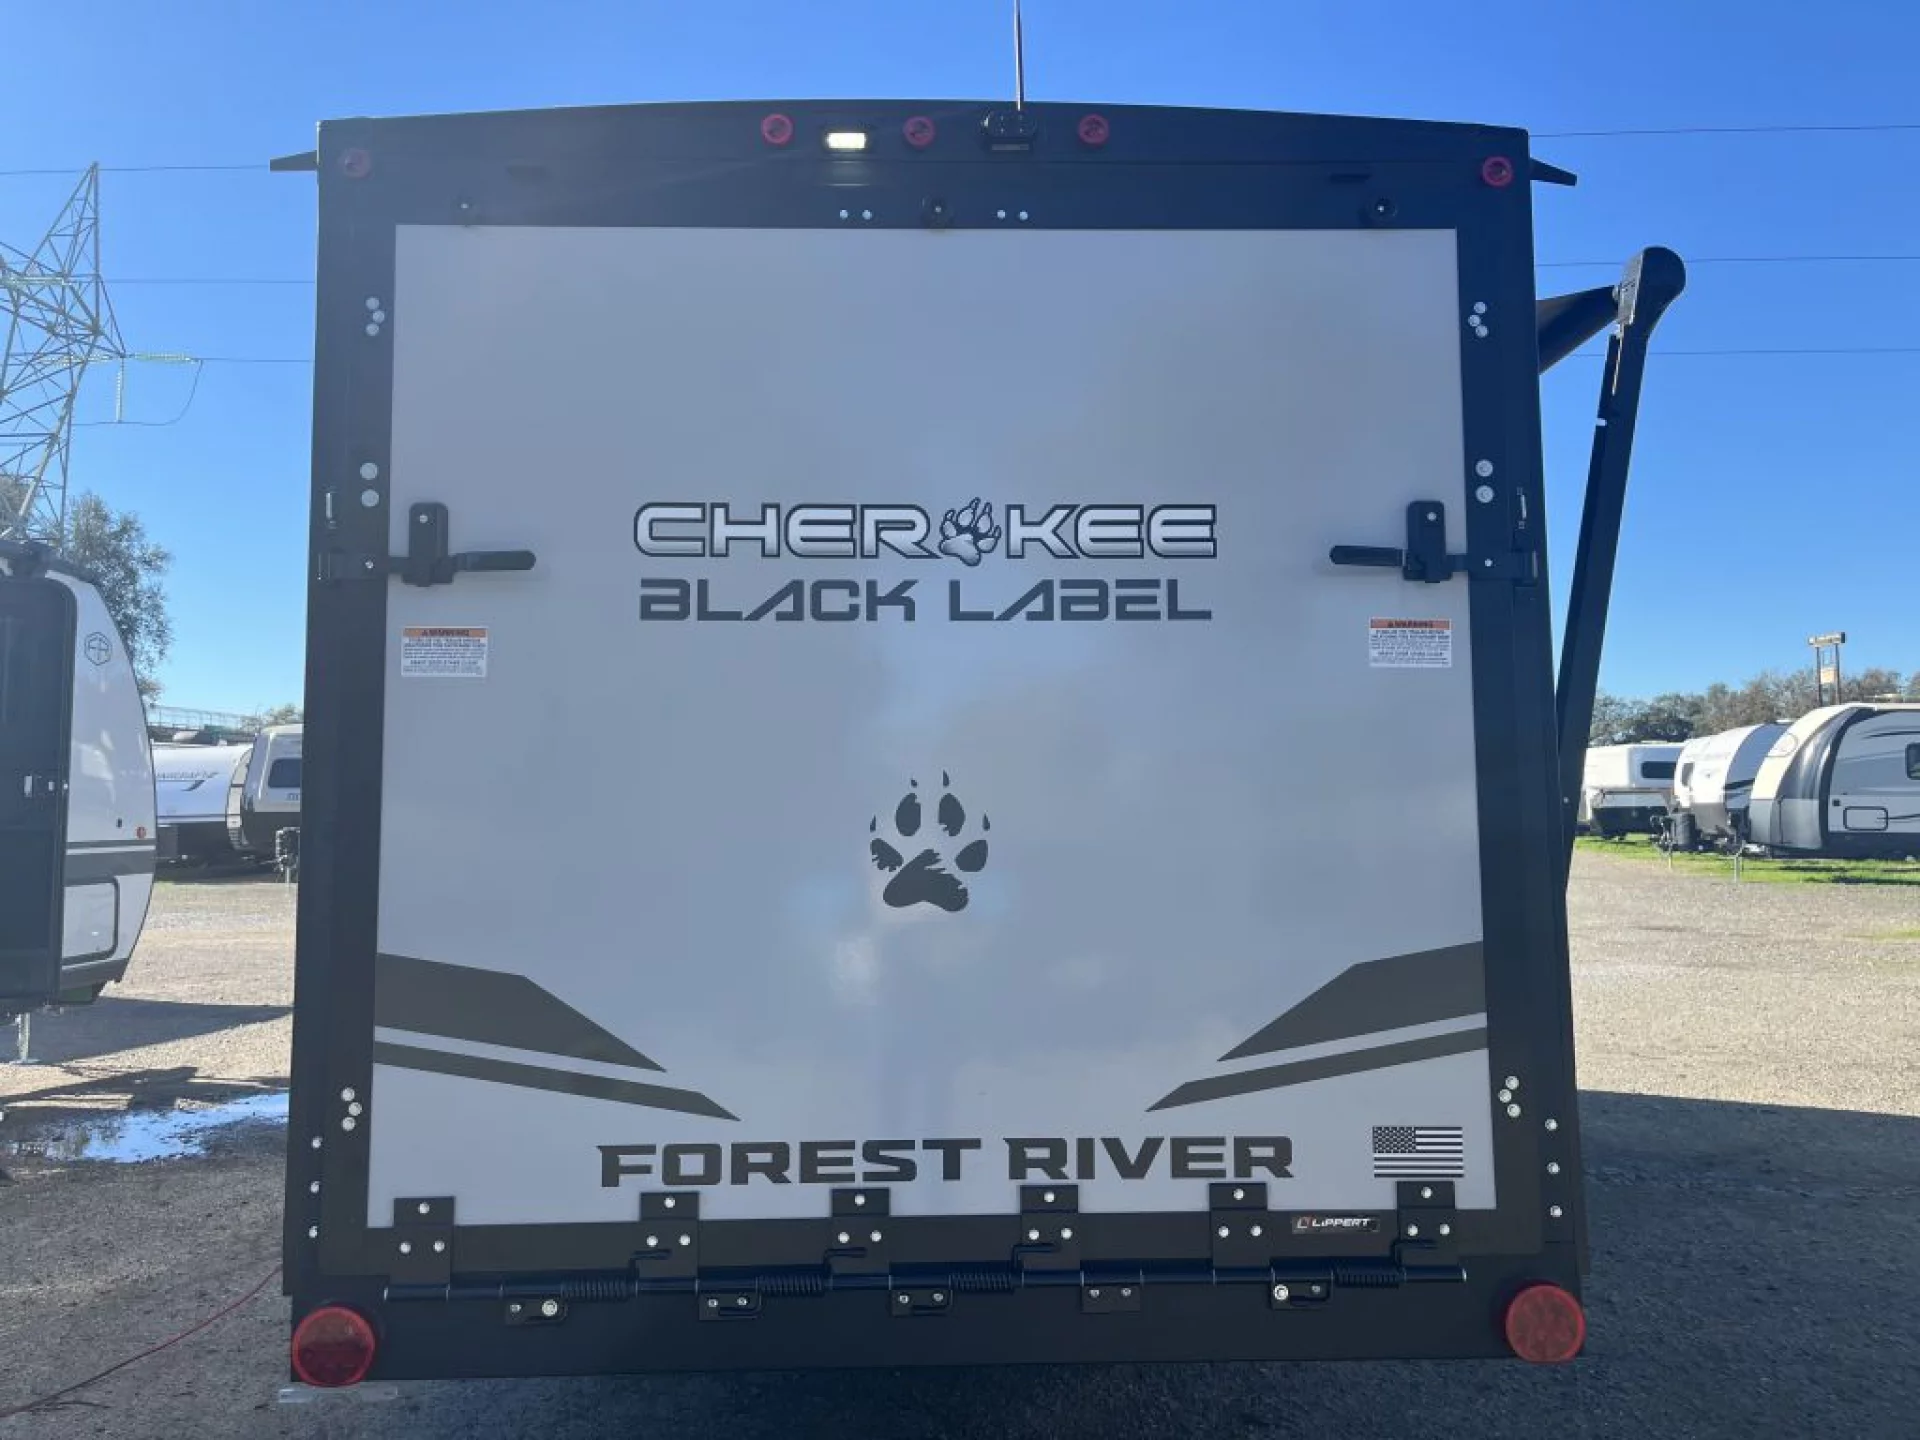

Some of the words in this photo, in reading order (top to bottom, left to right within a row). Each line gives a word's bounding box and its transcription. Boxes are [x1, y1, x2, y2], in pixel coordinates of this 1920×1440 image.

[633, 500, 1217, 562] CHERKEE
[639, 578, 919, 622] BLACK
[949, 578, 1212, 622] LABEL
[596, 1137, 982, 1188] FOREST
[1003, 1135, 1295, 1180] RIVER
